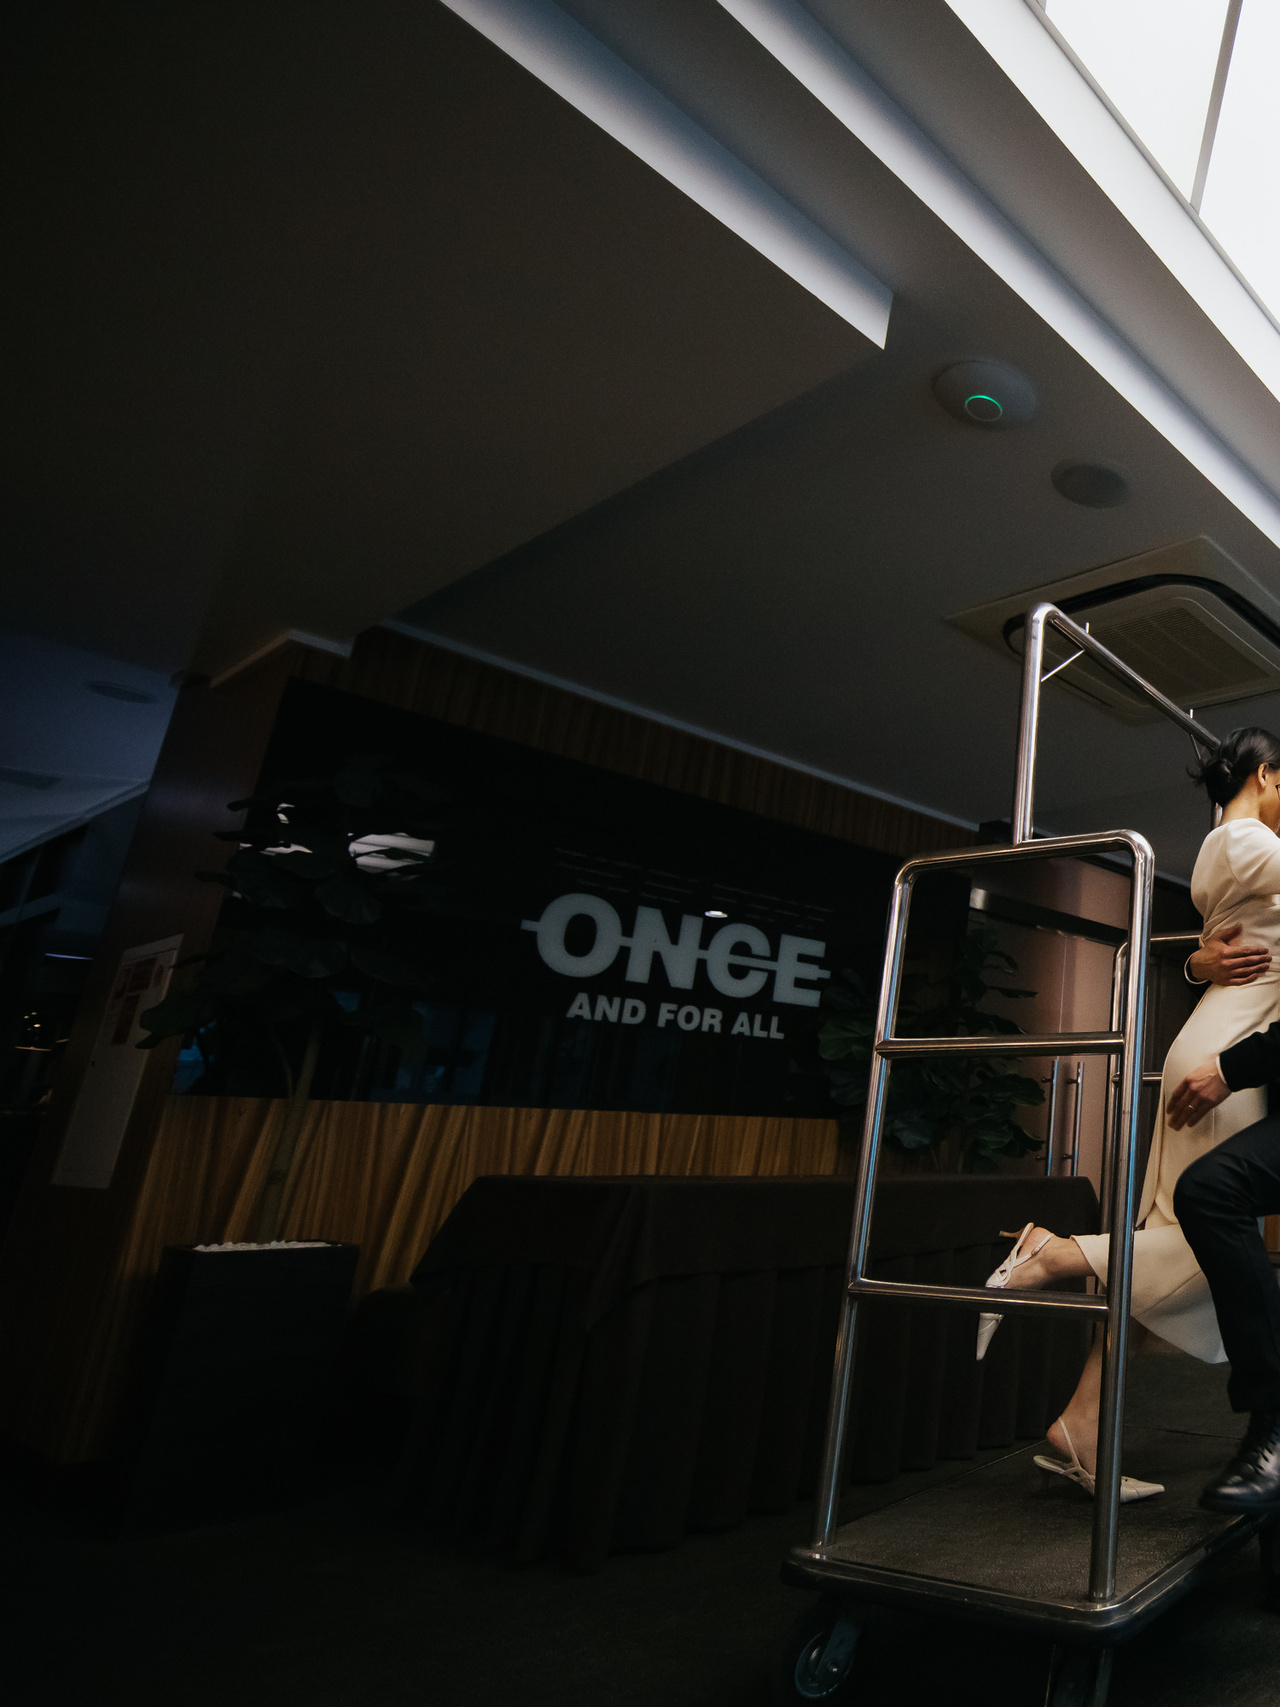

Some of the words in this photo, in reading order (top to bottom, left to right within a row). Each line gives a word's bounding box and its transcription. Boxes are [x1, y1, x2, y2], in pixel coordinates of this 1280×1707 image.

[520, 892, 832, 1008] ONCE
[565, 992, 647, 1025] AND
[656, 1002, 723, 1034] FOR
[730, 1012, 785, 1040] ALL
